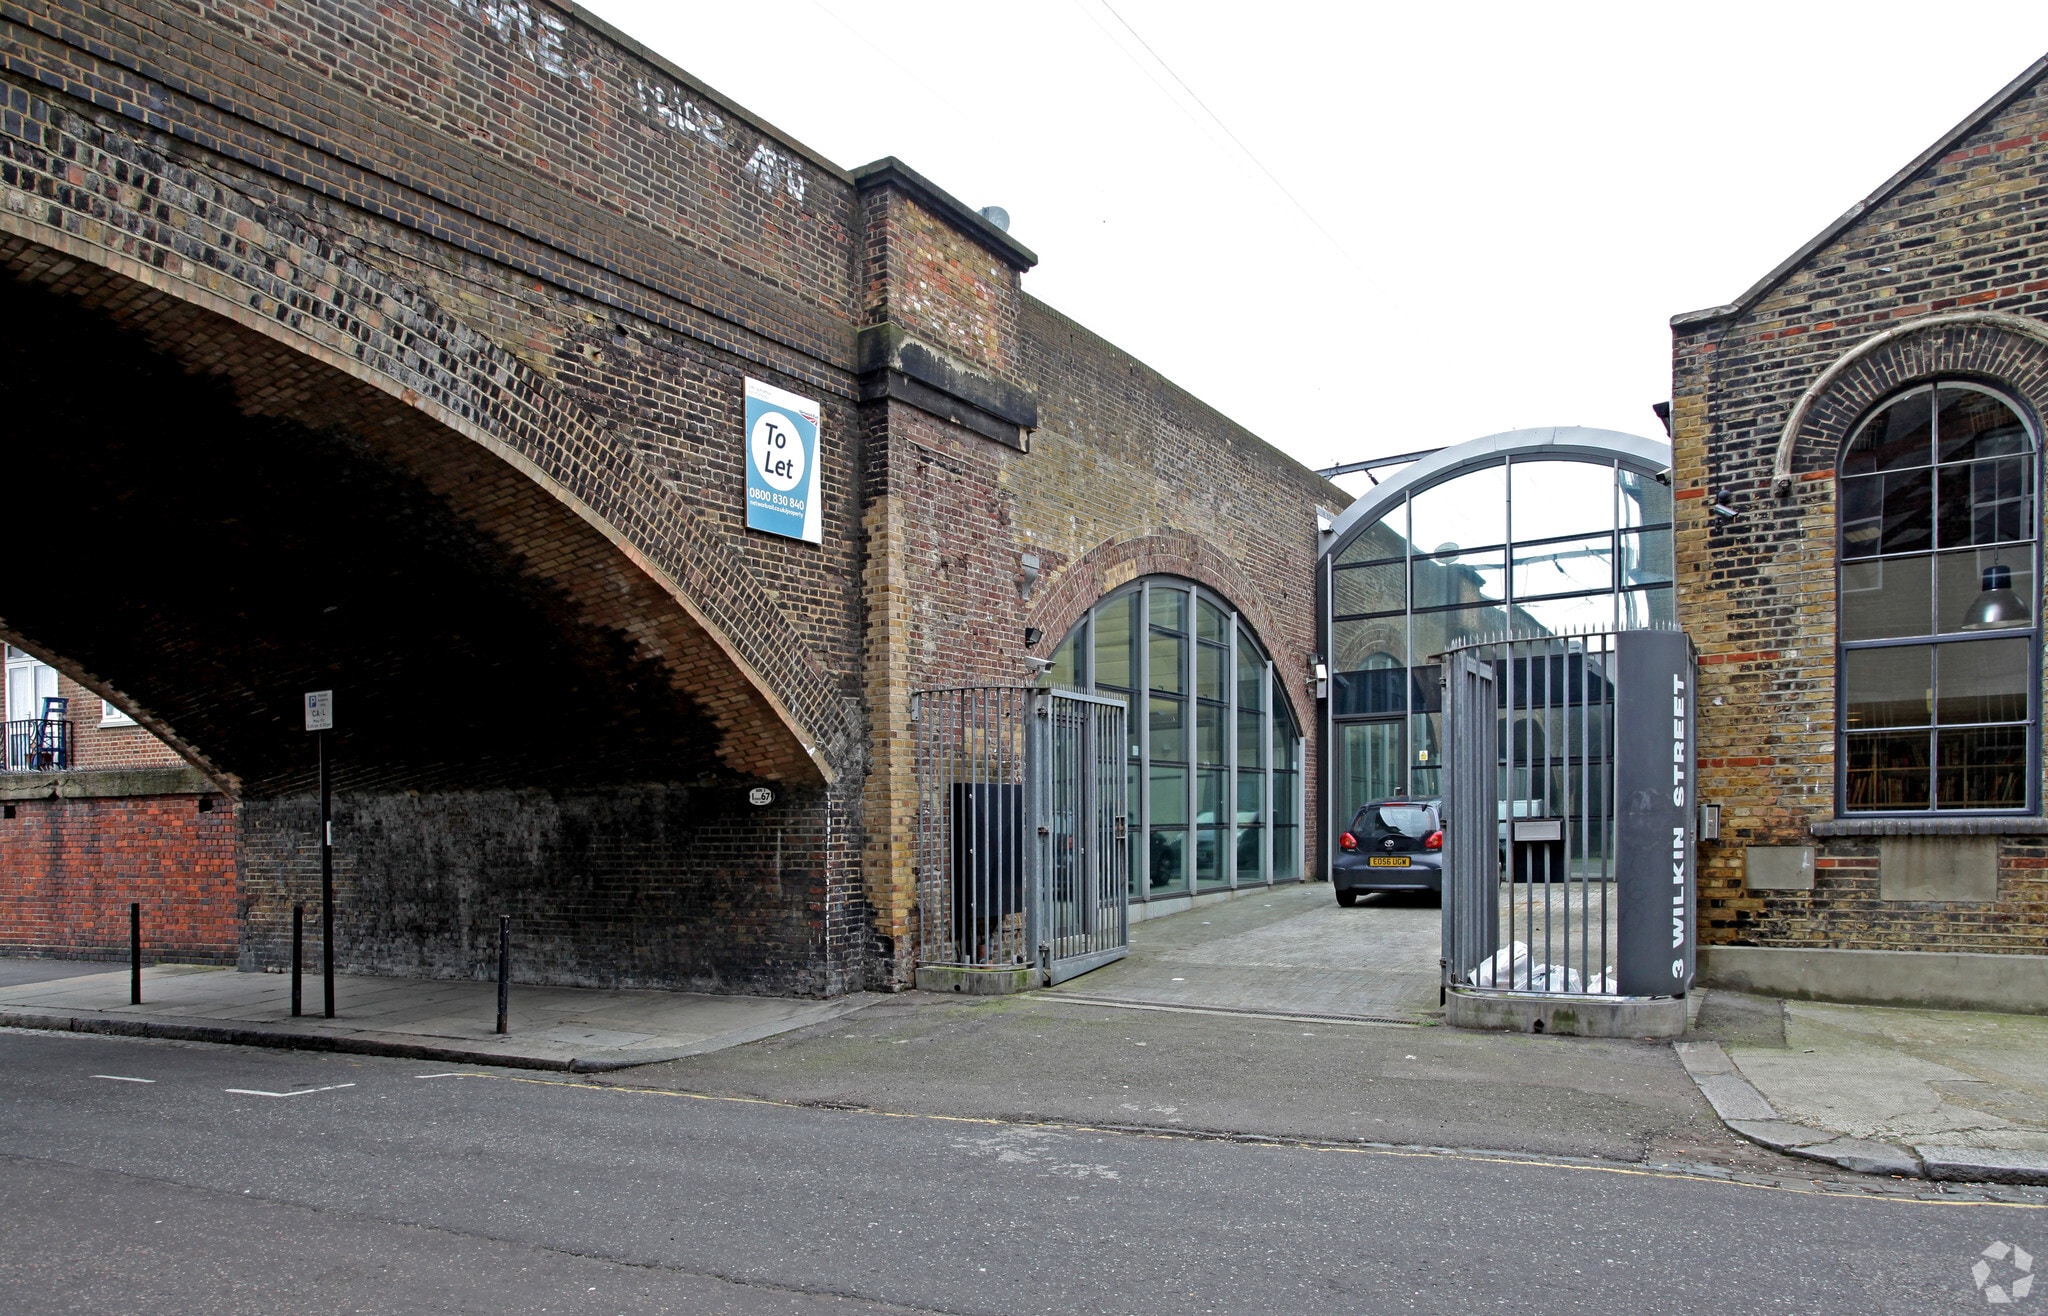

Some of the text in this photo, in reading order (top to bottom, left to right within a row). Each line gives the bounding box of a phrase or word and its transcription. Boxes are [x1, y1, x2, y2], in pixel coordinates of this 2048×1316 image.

[766, 422, 786, 449] To
[765, 450, 793, 480] Let
[750, 487, 805, 511] 0800 830 840
[1672, 673, 1685, 979] 3 WILKIN STREET
